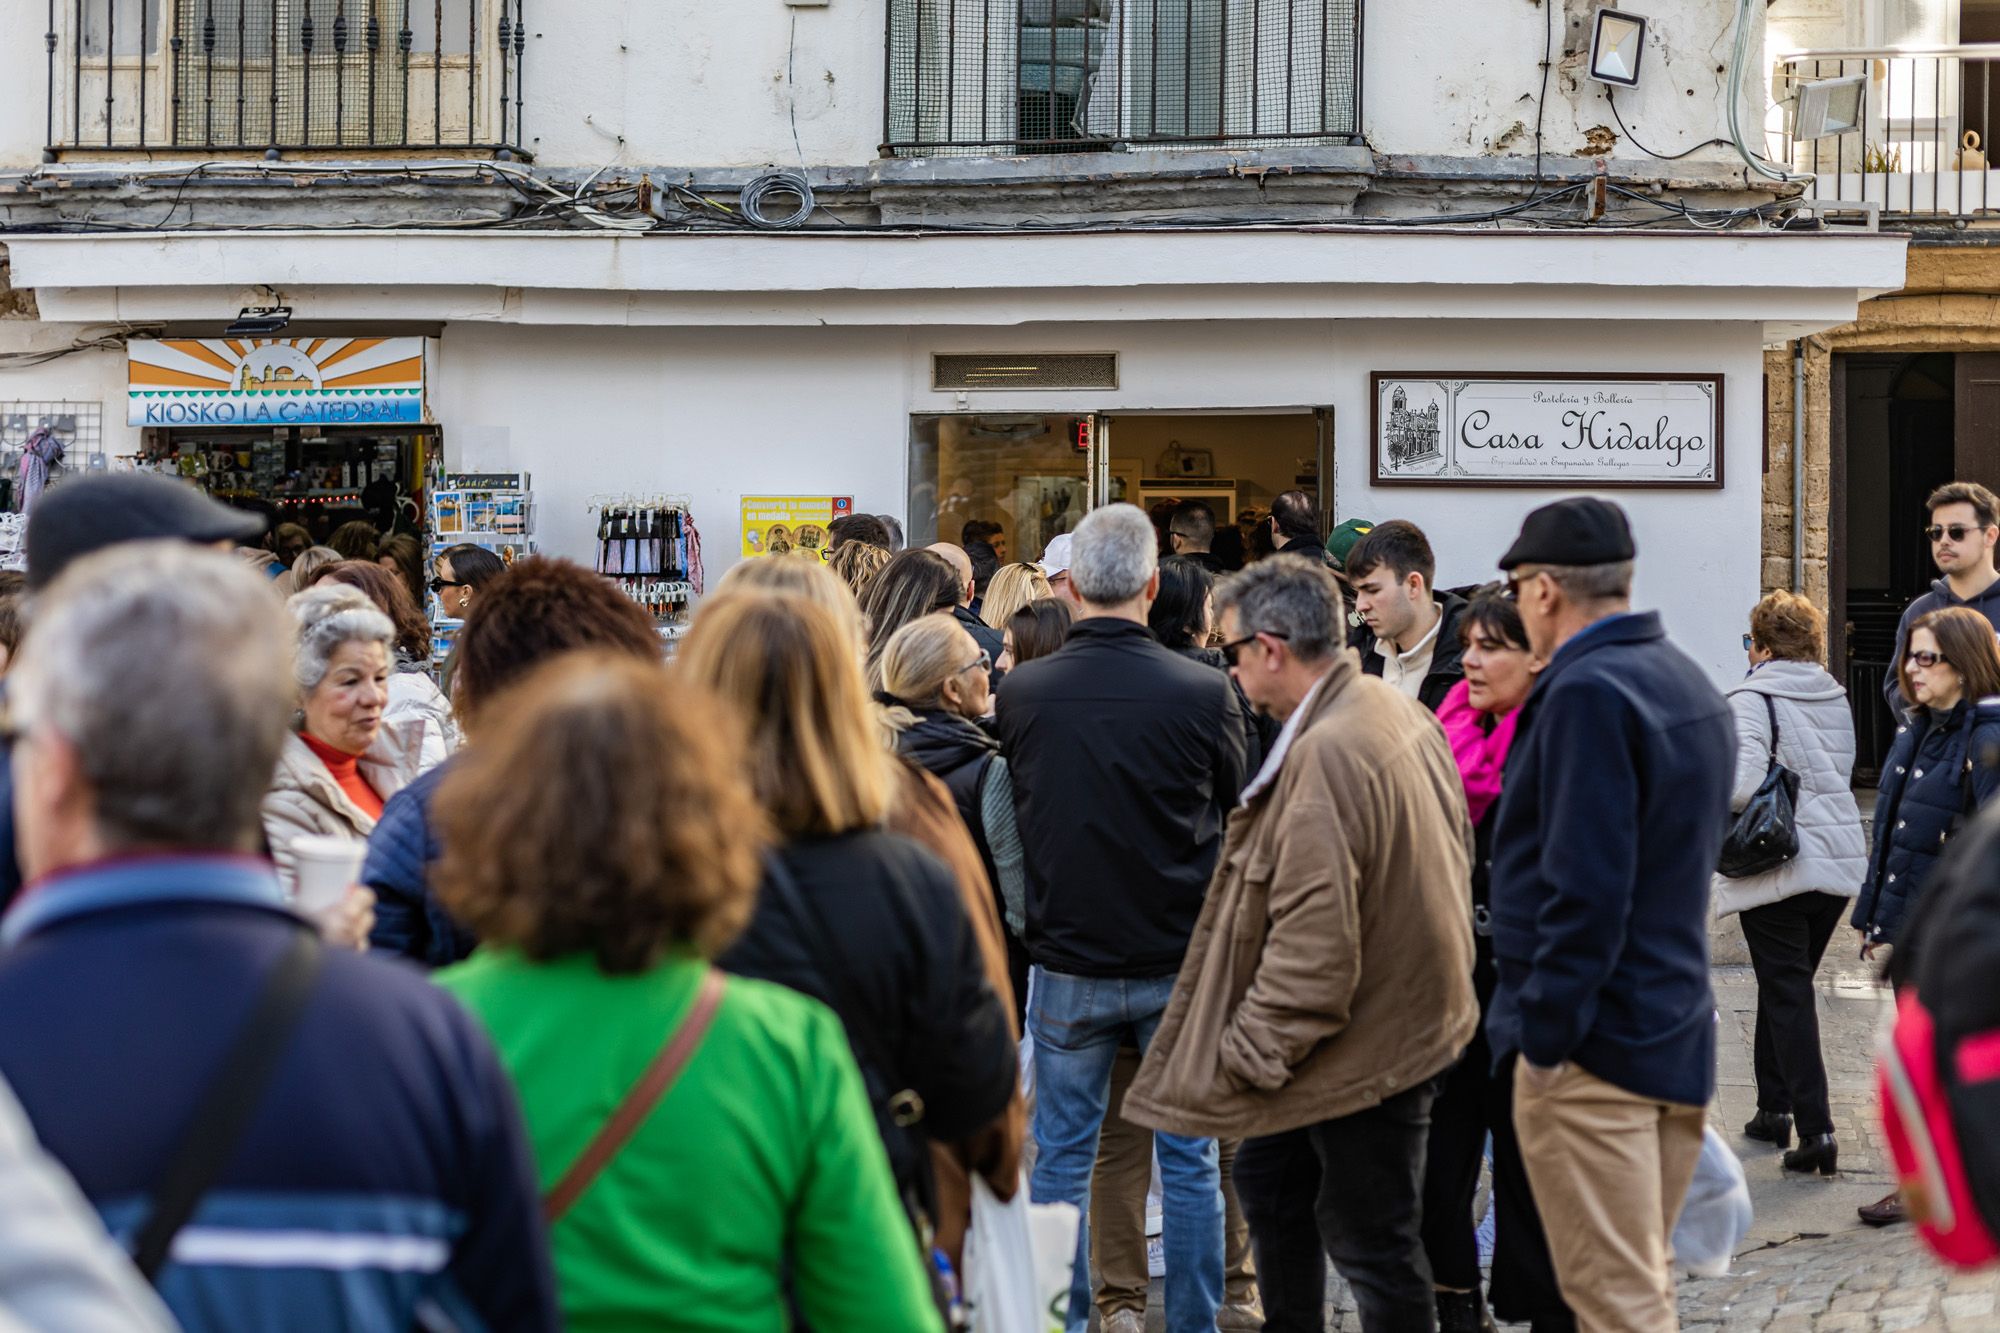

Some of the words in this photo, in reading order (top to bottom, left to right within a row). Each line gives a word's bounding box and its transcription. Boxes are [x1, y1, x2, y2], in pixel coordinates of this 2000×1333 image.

[1583, 395, 1591, 407] y
[146, 402, 235, 423] KIOSKO
[243, 401, 273, 422] LA
[278, 400, 406, 422] CATEDRAL
[1461, 410, 1543, 450] Casa
[1561, 411, 1706, 467] Hidalgo
[1550, 455, 1594, 469] Empanadas
